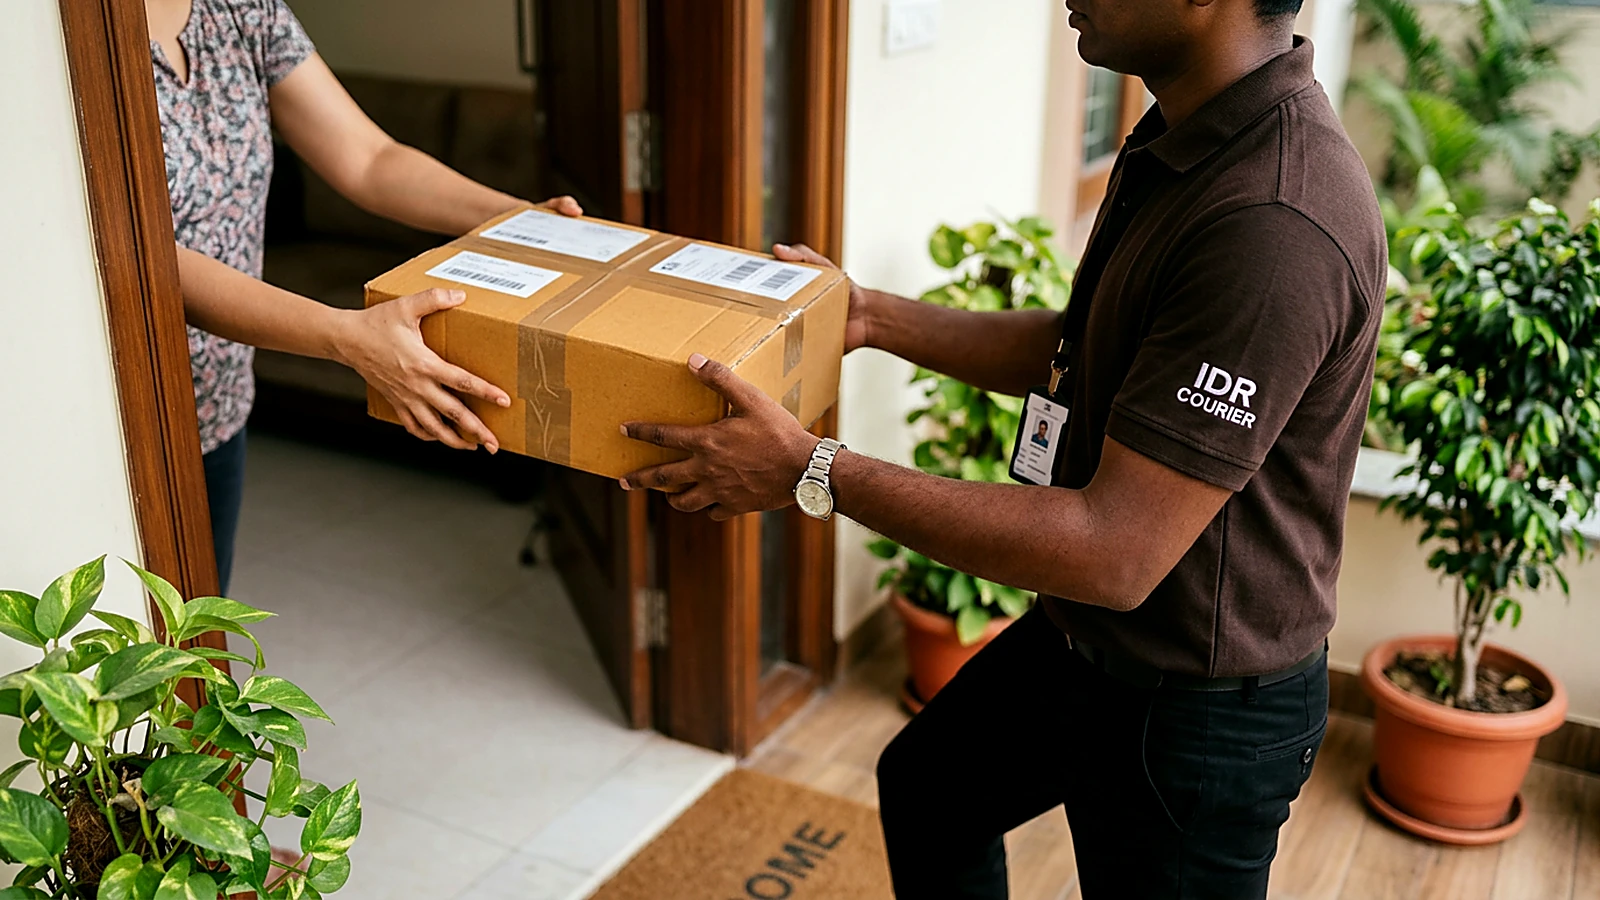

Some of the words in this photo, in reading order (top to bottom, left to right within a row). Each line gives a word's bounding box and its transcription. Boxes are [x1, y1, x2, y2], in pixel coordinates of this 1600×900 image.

[1176, 387, 1257, 429] COURIER
[1193, 362, 1257, 408] IDR
[735, 821, 847, 900] OME
